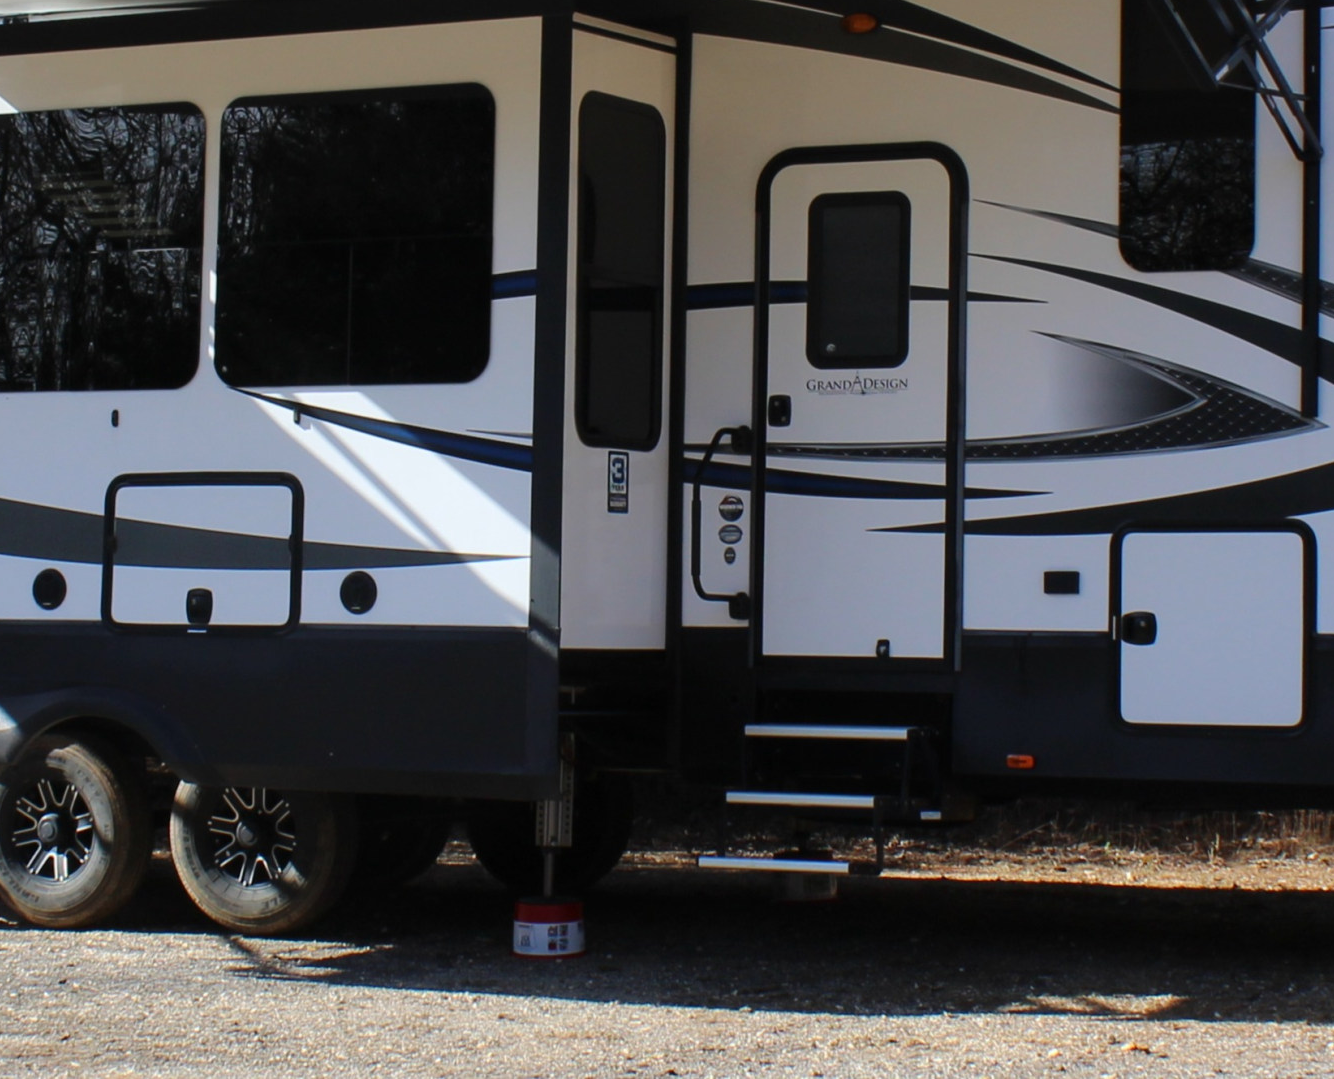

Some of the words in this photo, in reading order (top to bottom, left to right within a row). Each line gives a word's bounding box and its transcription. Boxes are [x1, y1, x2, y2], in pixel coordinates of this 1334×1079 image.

[806, 379, 852, 392] GRAND
[863, 377, 908, 390] DESIGN
[612, 457, 625, 484] 3
